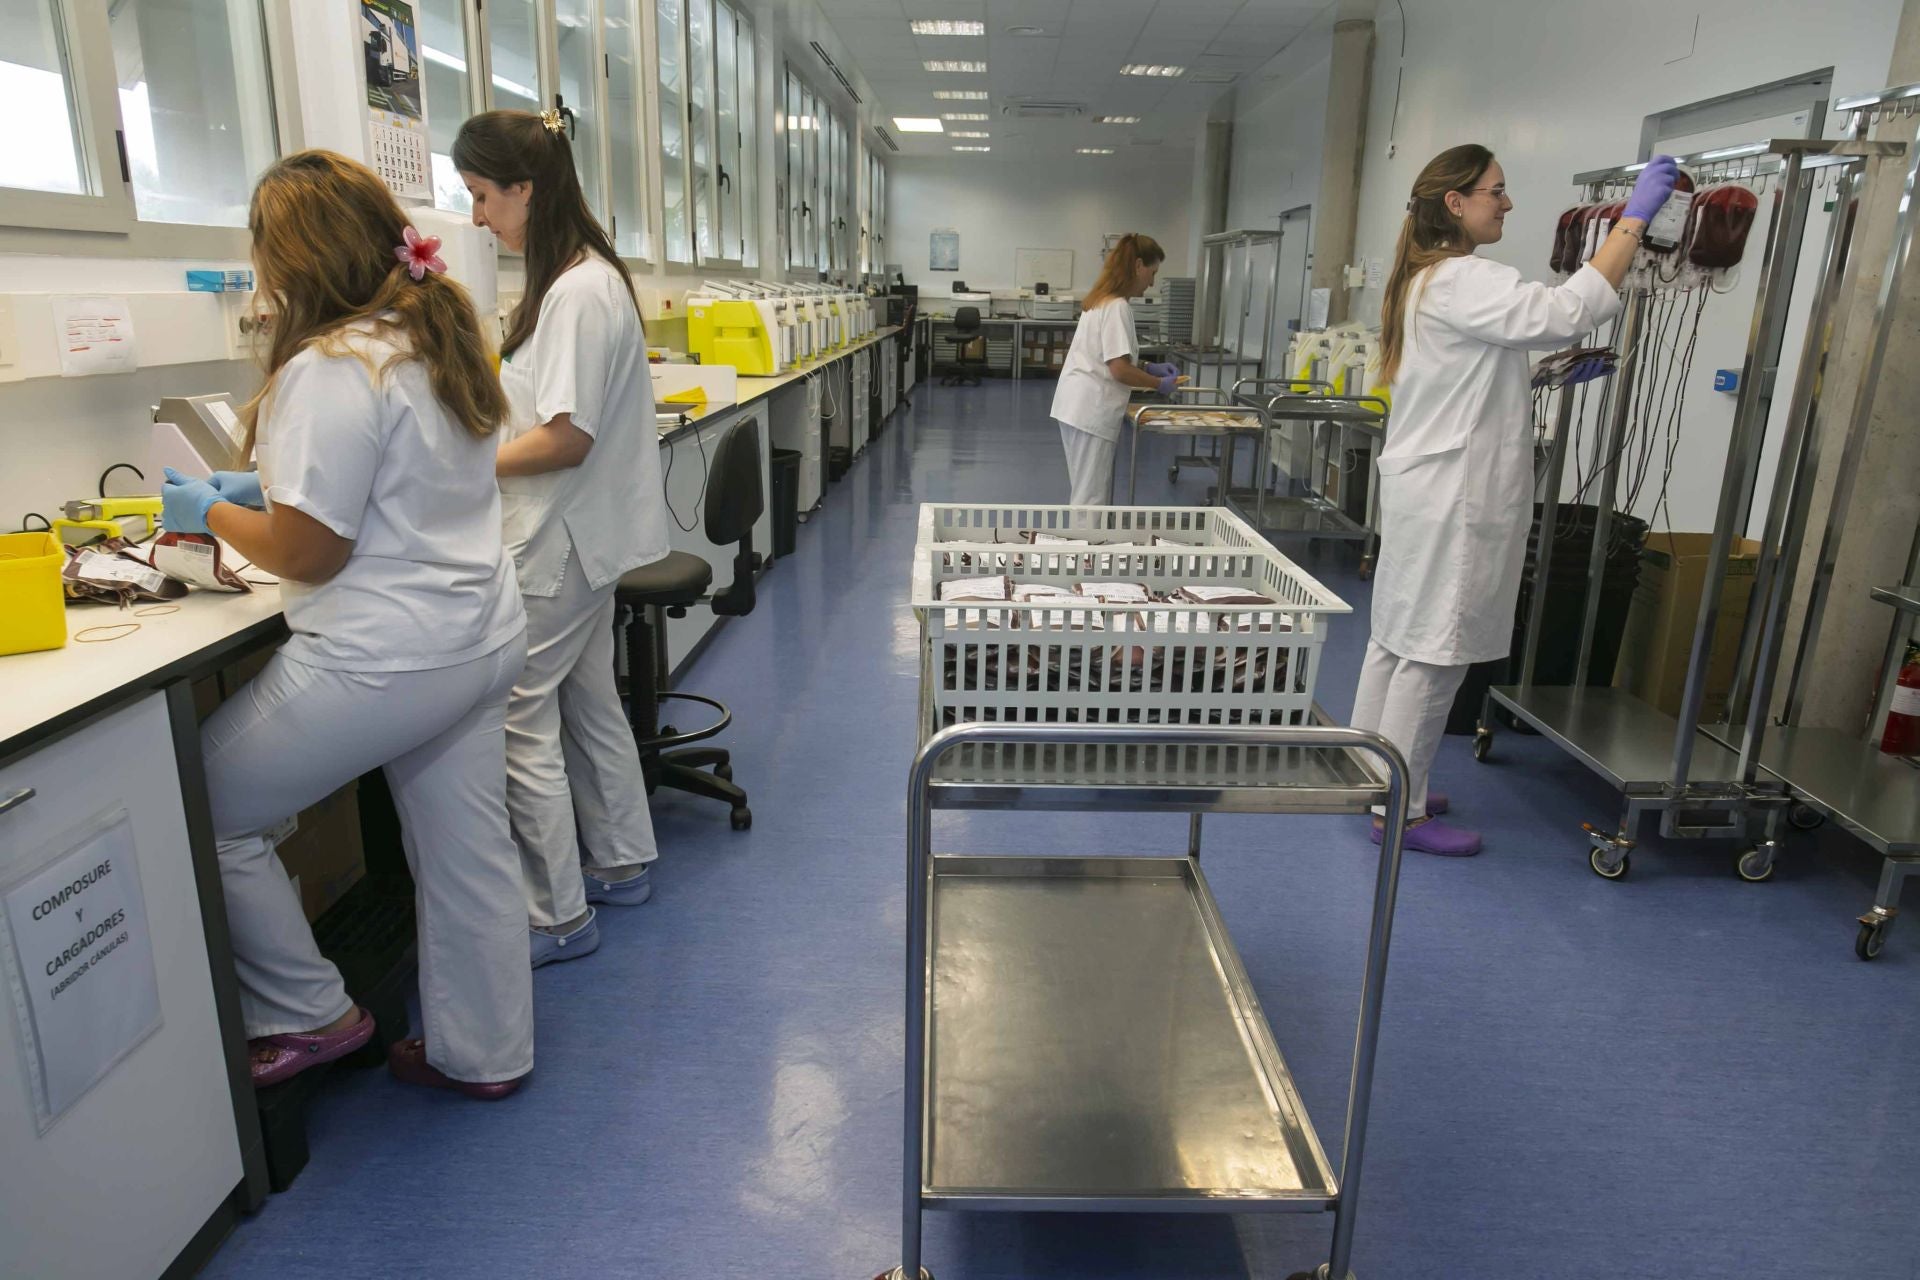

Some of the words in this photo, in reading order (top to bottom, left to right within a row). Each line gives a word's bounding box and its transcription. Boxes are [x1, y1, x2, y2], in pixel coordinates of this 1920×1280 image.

[32, 860, 112, 921] COMPOSURE
[75, 908, 84, 922] Y
[46, 908, 125, 977] CARGADORES
[50, 961, 90, 1000] (ABRIDOR
